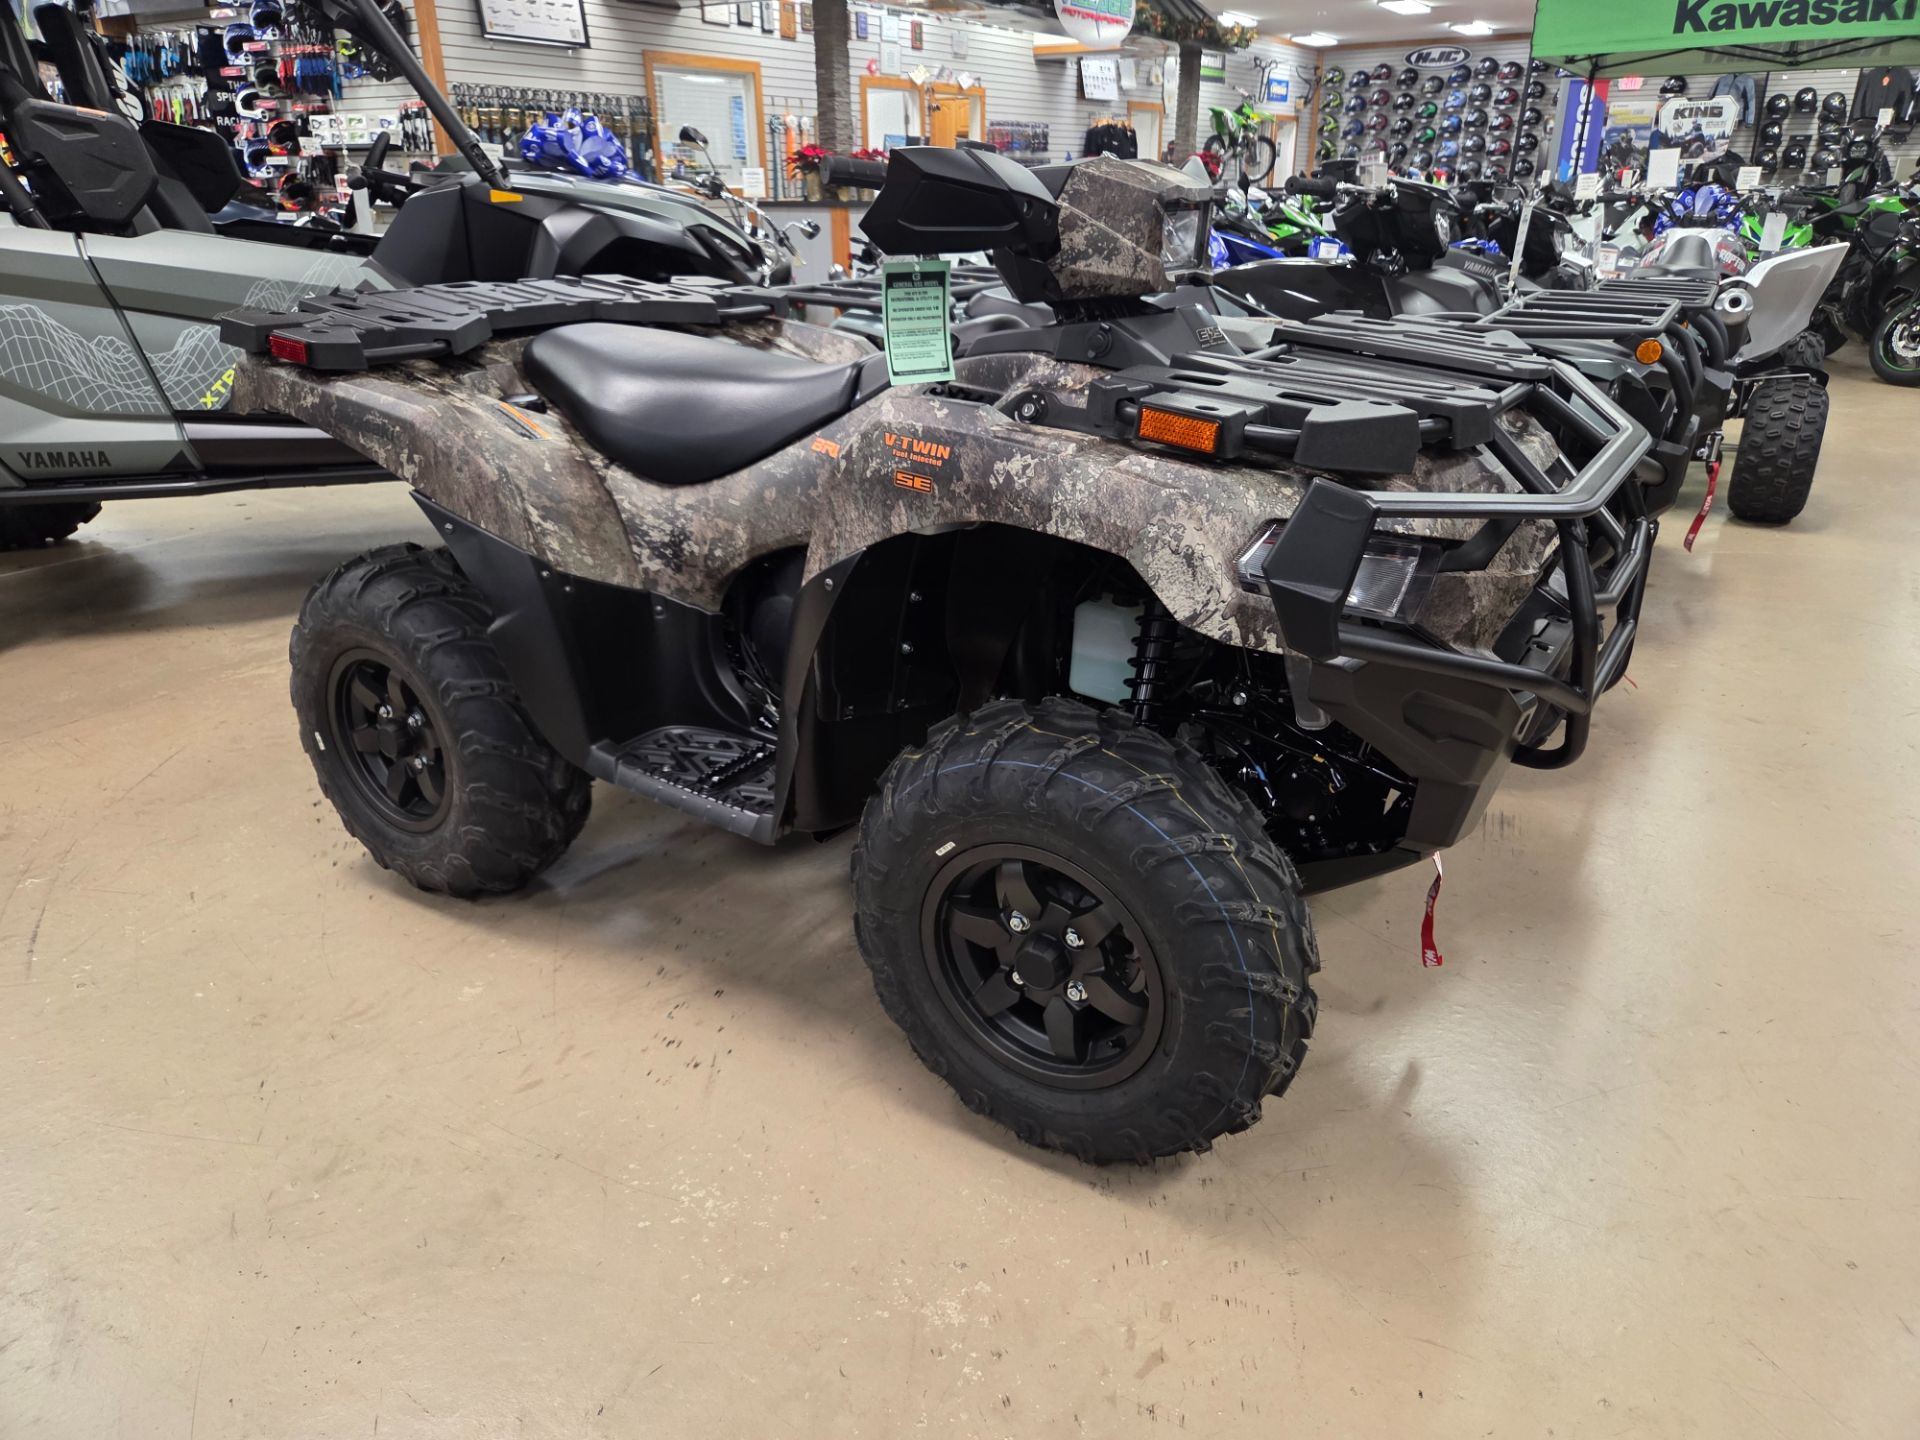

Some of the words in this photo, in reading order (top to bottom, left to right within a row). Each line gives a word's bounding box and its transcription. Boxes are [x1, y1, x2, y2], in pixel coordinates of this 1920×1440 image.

[1673, 0, 1918, 34] Kawasaki
[1412, 50, 1462, 64] HJC
[1673, 106, 1723, 120] KING
[1566, 84, 1596, 178] SUZUK
[1463, 260, 1497, 277] YAMAHA
[884, 432, 951, 459] V-TWIN
[18, 451, 112, 469] YAMAHA
[892, 448, 909, 459] Fuel
[909, 452, 943, 467] Injected
[895, 471, 932, 492] SE
